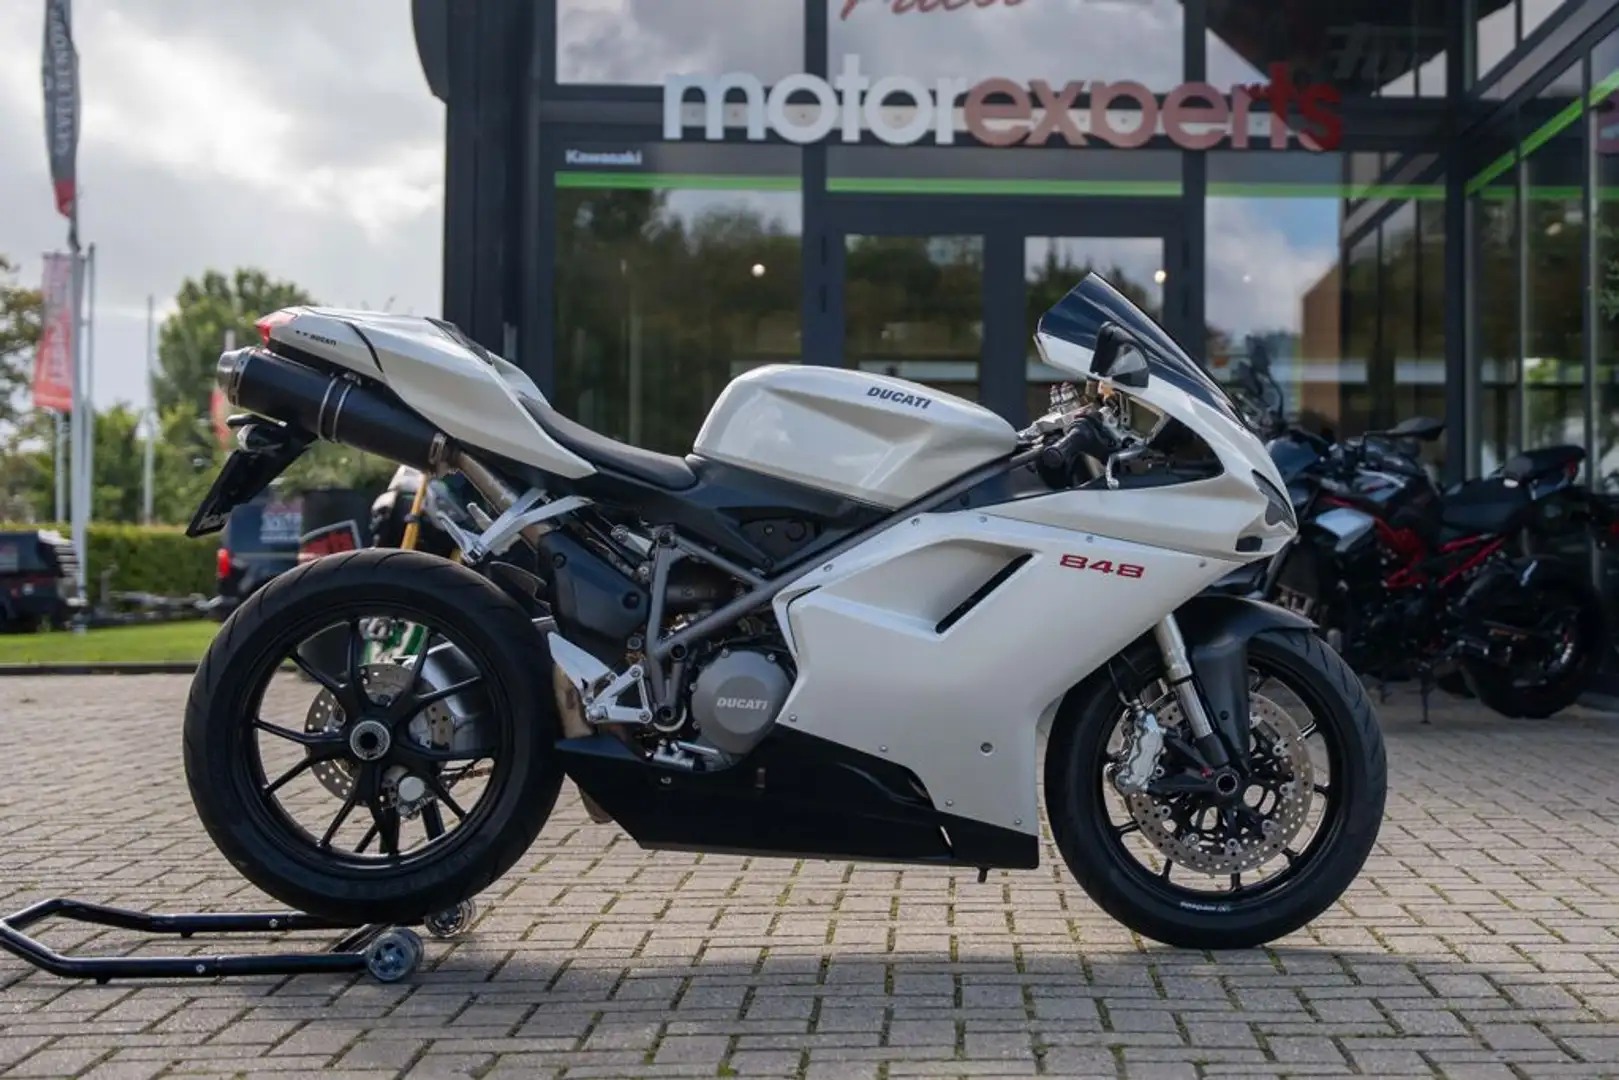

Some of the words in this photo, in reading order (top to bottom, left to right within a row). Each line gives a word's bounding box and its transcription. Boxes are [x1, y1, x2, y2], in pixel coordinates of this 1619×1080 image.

[662, 53, 1344, 153] motorexperts
[866, 386, 932, 409] DUCATI
[1060, 553, 1145, 579] 848
[716, 696, 769, 711] DUCATI
